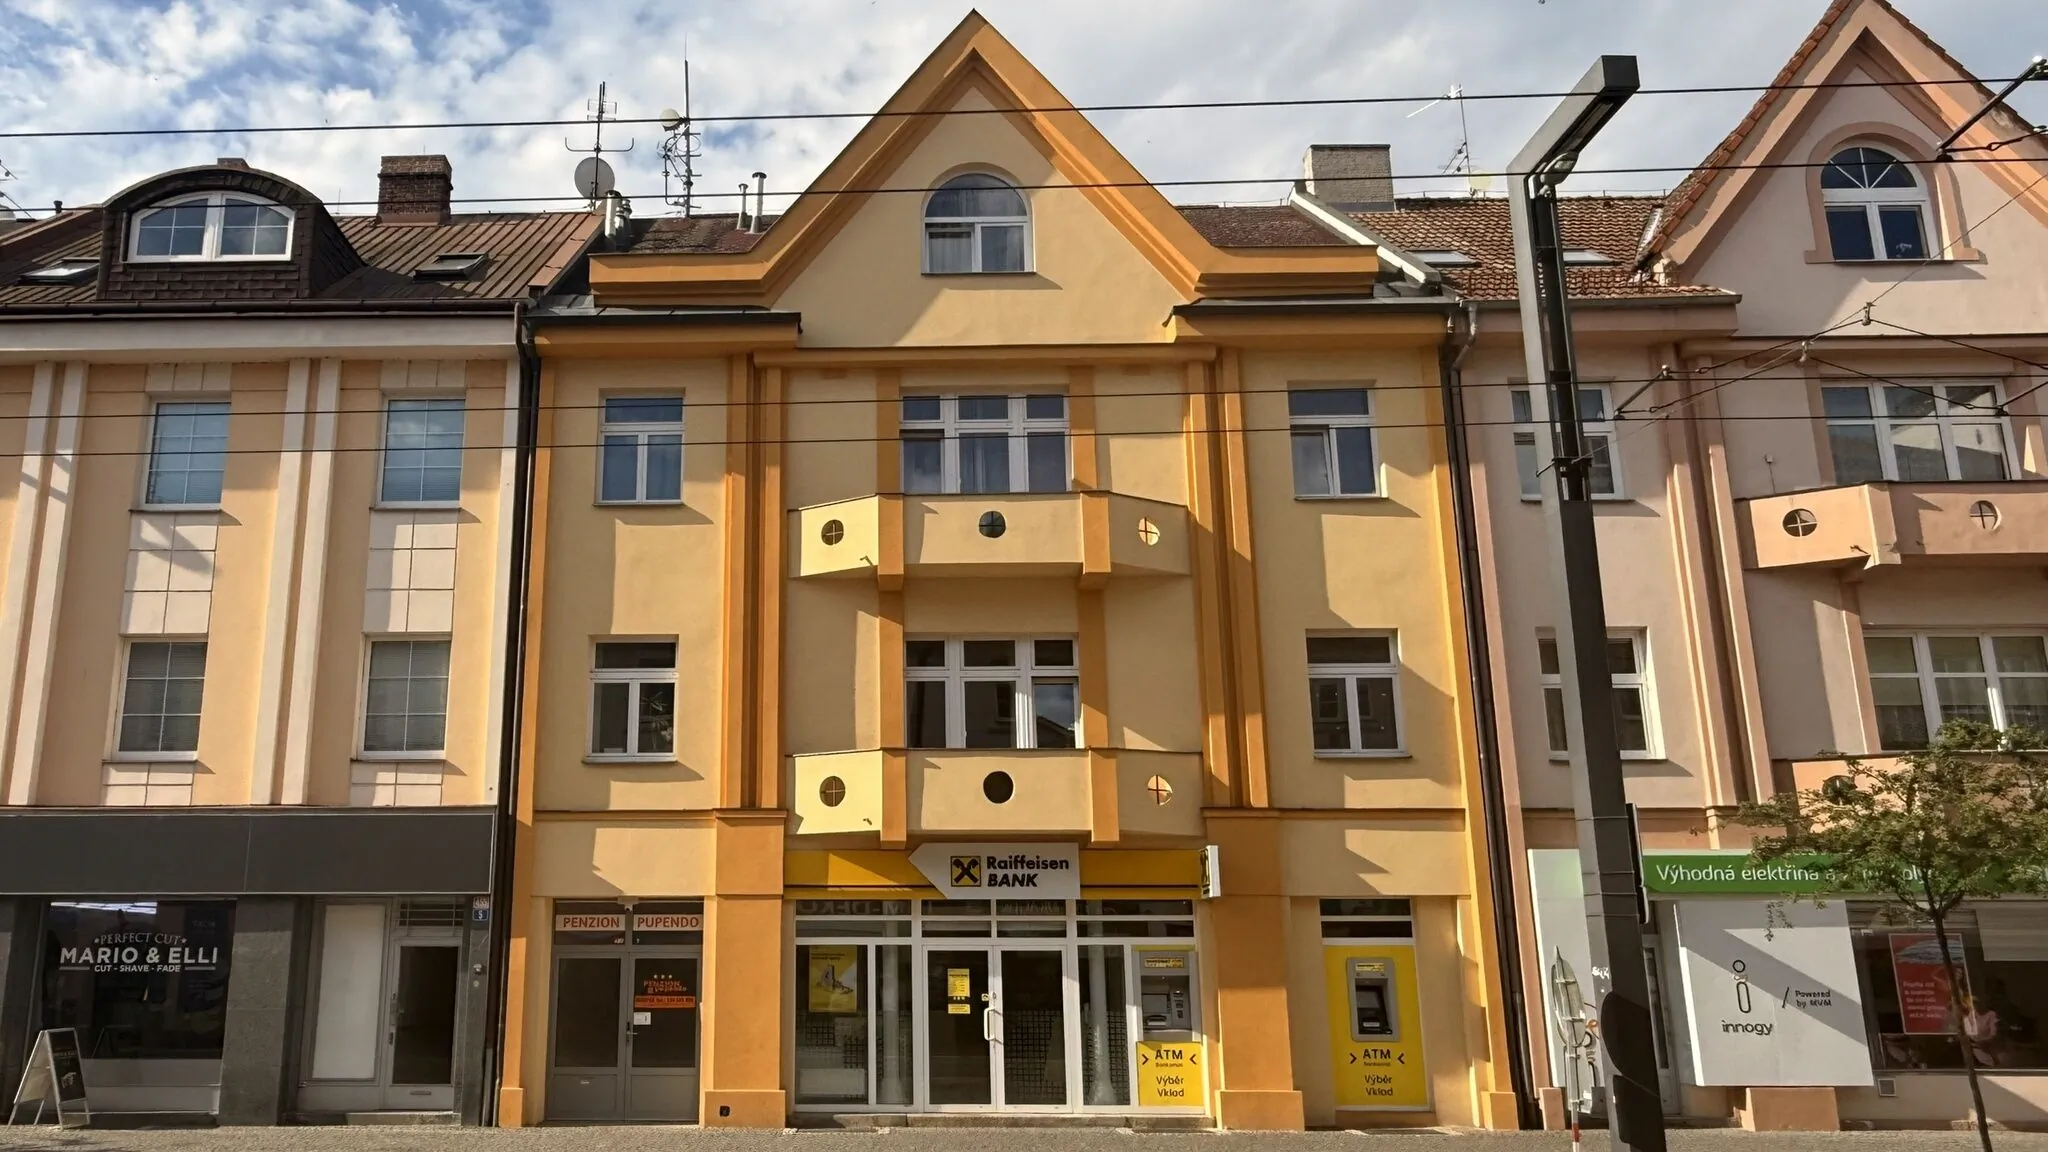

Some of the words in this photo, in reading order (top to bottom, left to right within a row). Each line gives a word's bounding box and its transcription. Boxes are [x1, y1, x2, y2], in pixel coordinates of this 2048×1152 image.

[987, 855, 1069, 870] Raiffeisen
[987, 873, 1038, 887] BANK
[1656, 864, 1735, 885] Výhodná
[1741, 864, 1819, 881] elektřina
[563, 916, 620, 928] PENZION
[637, 916, 699, 928] PUPENDO
[100, 932, 152, 944] PERFECT
[154, 932, 182, 945] CUT
[60, 947, 139, 964] MARIO
[146, 947, 160, 964] &
[168, 947, 218, 964] ELLI
[94, 964, 113, 972] CUT
[119, 964, 149, 972] SHAVE
[156, 964, 181, 972] FADE
[1794, 990, 1831, 998] Powered
[1796, 1000, 1806, 1008] by
[1721, 1020, 1773, 1035] innogy
[1155, 1049, 1183, 1060] ATM
[1363, 1049, 1391, 1059] ATM
[1156, 1075, 1184, 1087] Výběr
[1157, 1087, 1185, 1097] Vklad
